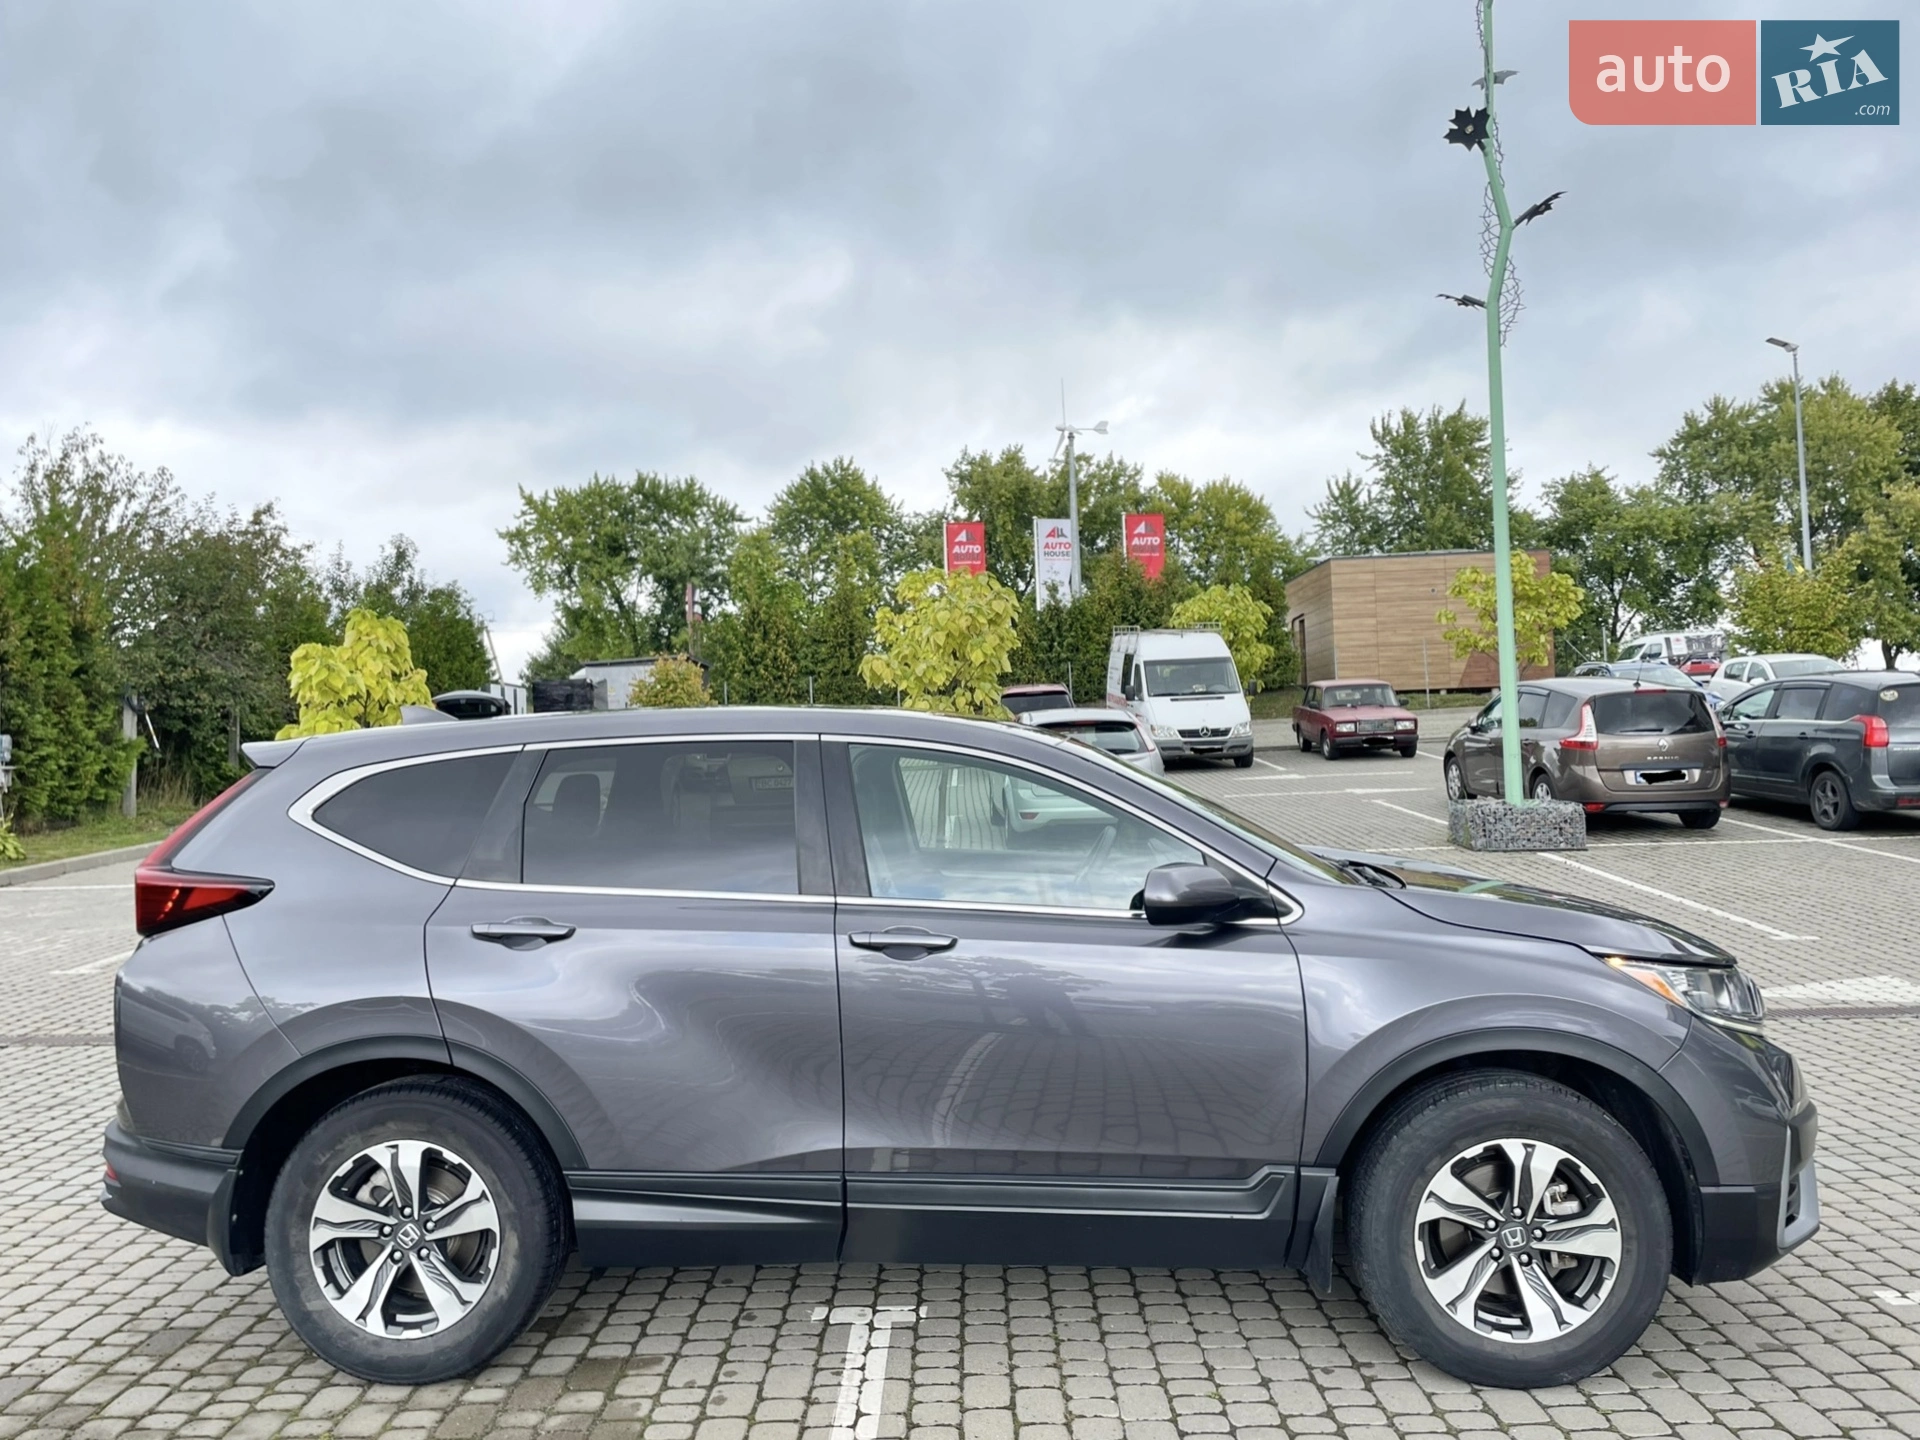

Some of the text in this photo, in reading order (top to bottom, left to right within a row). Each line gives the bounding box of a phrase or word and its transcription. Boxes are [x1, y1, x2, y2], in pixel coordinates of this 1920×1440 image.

[1131, 537, 1160, 545] AUTO
[952, 545, 981, 553] AUTO
[1043, 541, 1073, 550] AUTO
